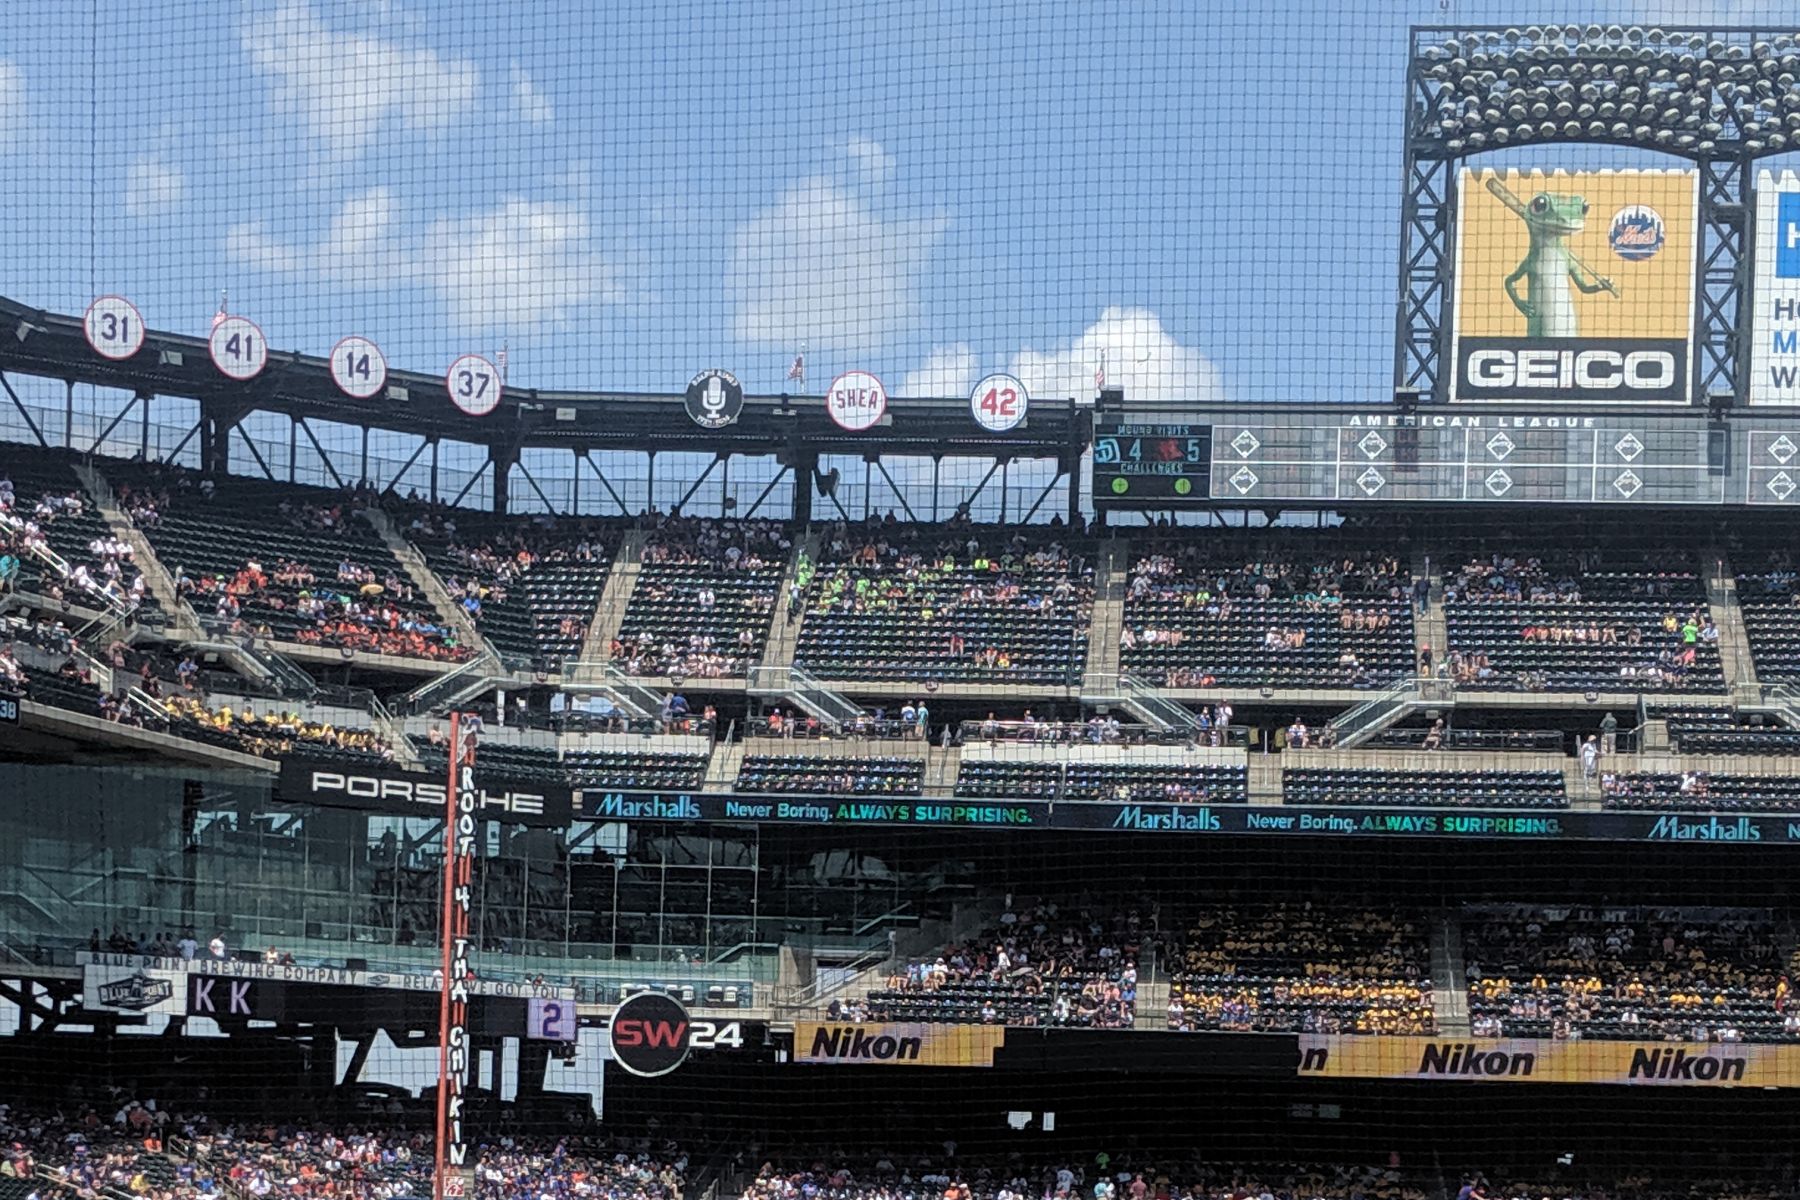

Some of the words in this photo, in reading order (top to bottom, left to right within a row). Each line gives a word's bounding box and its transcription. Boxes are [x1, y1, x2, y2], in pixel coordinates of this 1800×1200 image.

[1774, 298, 1800, 321] H
[101, 312, 129, 343] 31
[224, 334, 252, 361] 41
[346, 351, 371, 380] 14
[1467, 350, 1675, 389] GEICO
[1770, 366, 1800, 389] W
[457, 370, 489, 399] 37
[835, 391, 878, 410] SHEA
[980, 388, 1016, 416] 42
[1349, 415, 1480, 427] AMERICAN
[1499, 416, 1596, 428] LEAGUE
[1128, 439, 1142, 461] 4
[1187, 439, 1200, 462] 5
[312, 772, 545, 814] PORSHE
[596, 793, 700, 819] Marshalls
[726, 801, 772, 817] Never
[777, 802, 833, 822] Boring.
[837, 805, 909, 820] ALWAYS
[915, 807, 1033, 823] SURPRISING.
[1113, 807, 1220, 830] Marshalls
[1247, 813, 1295, 828] Never
[1300, 814, 1358, 832] Boring.
[1361, 816, 1437, 831] ALWAYS
[1443, 817, 1563, 834] SURPRISING.
[1648, 816, 1760, 840] Marshalls
[92, 953, 133, 967] BLUE
[200, 964, 275, 978] BREWING
[284, 966, 357, 984] COMPANY
[195, 979, 216, 1012] K
[230, 981, 252, 1013] K
[403, 976, 441, 991] RELA
[532, 986, 561, 999] YOU
[543, 1004, 561, 1037] 2
[811, 1027, 922, 1060] Nikon
[1418, 1044, 1535, 1077] Nikon
[1629, 1048, 1746, 1081] Nikon
